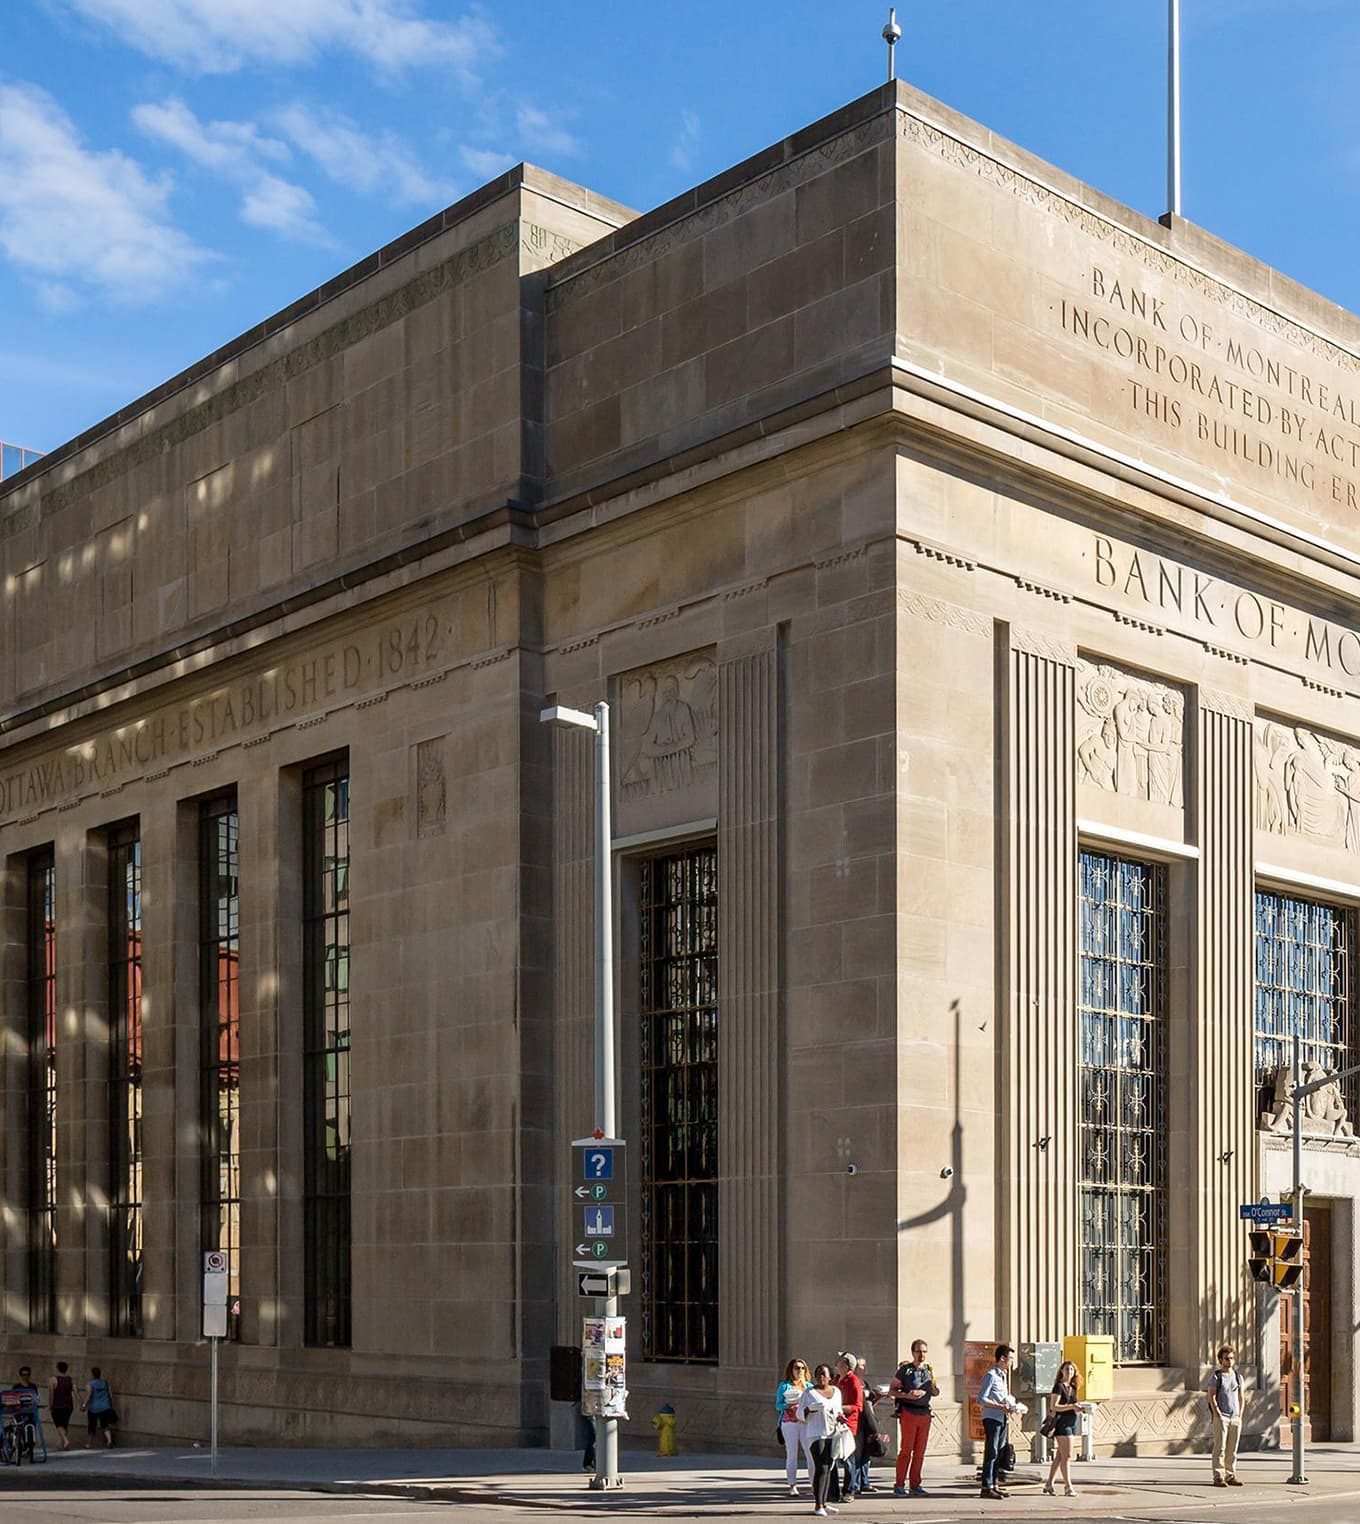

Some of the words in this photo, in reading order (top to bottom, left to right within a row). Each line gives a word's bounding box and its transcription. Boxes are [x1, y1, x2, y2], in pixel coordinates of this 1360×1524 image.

[1061, 300, 1272, 425] INCORPORATED
[1280, 408, 1307, 442] BY
[1315, 428, 1360, 468] ACT
[1092, 267, 1168, 332] BANK
[1179, 313, 1212, 350] OF
[1226, 338, 1360, 429] MONTREAL
[1127, 378, 1181, 429] THIS
[1198, 412, 1315, 491] BUILDING
[1094, 534, 1218, 627] BANK
[1234, 591, 1285, 648] OF
[74, 722, 165, 786] BRANCH
[178, 646, 362, 752] ESTABLISHED
[378, 614, 440, 680] 1842
[1251, 1207, 1280, 1217] O'Connor
